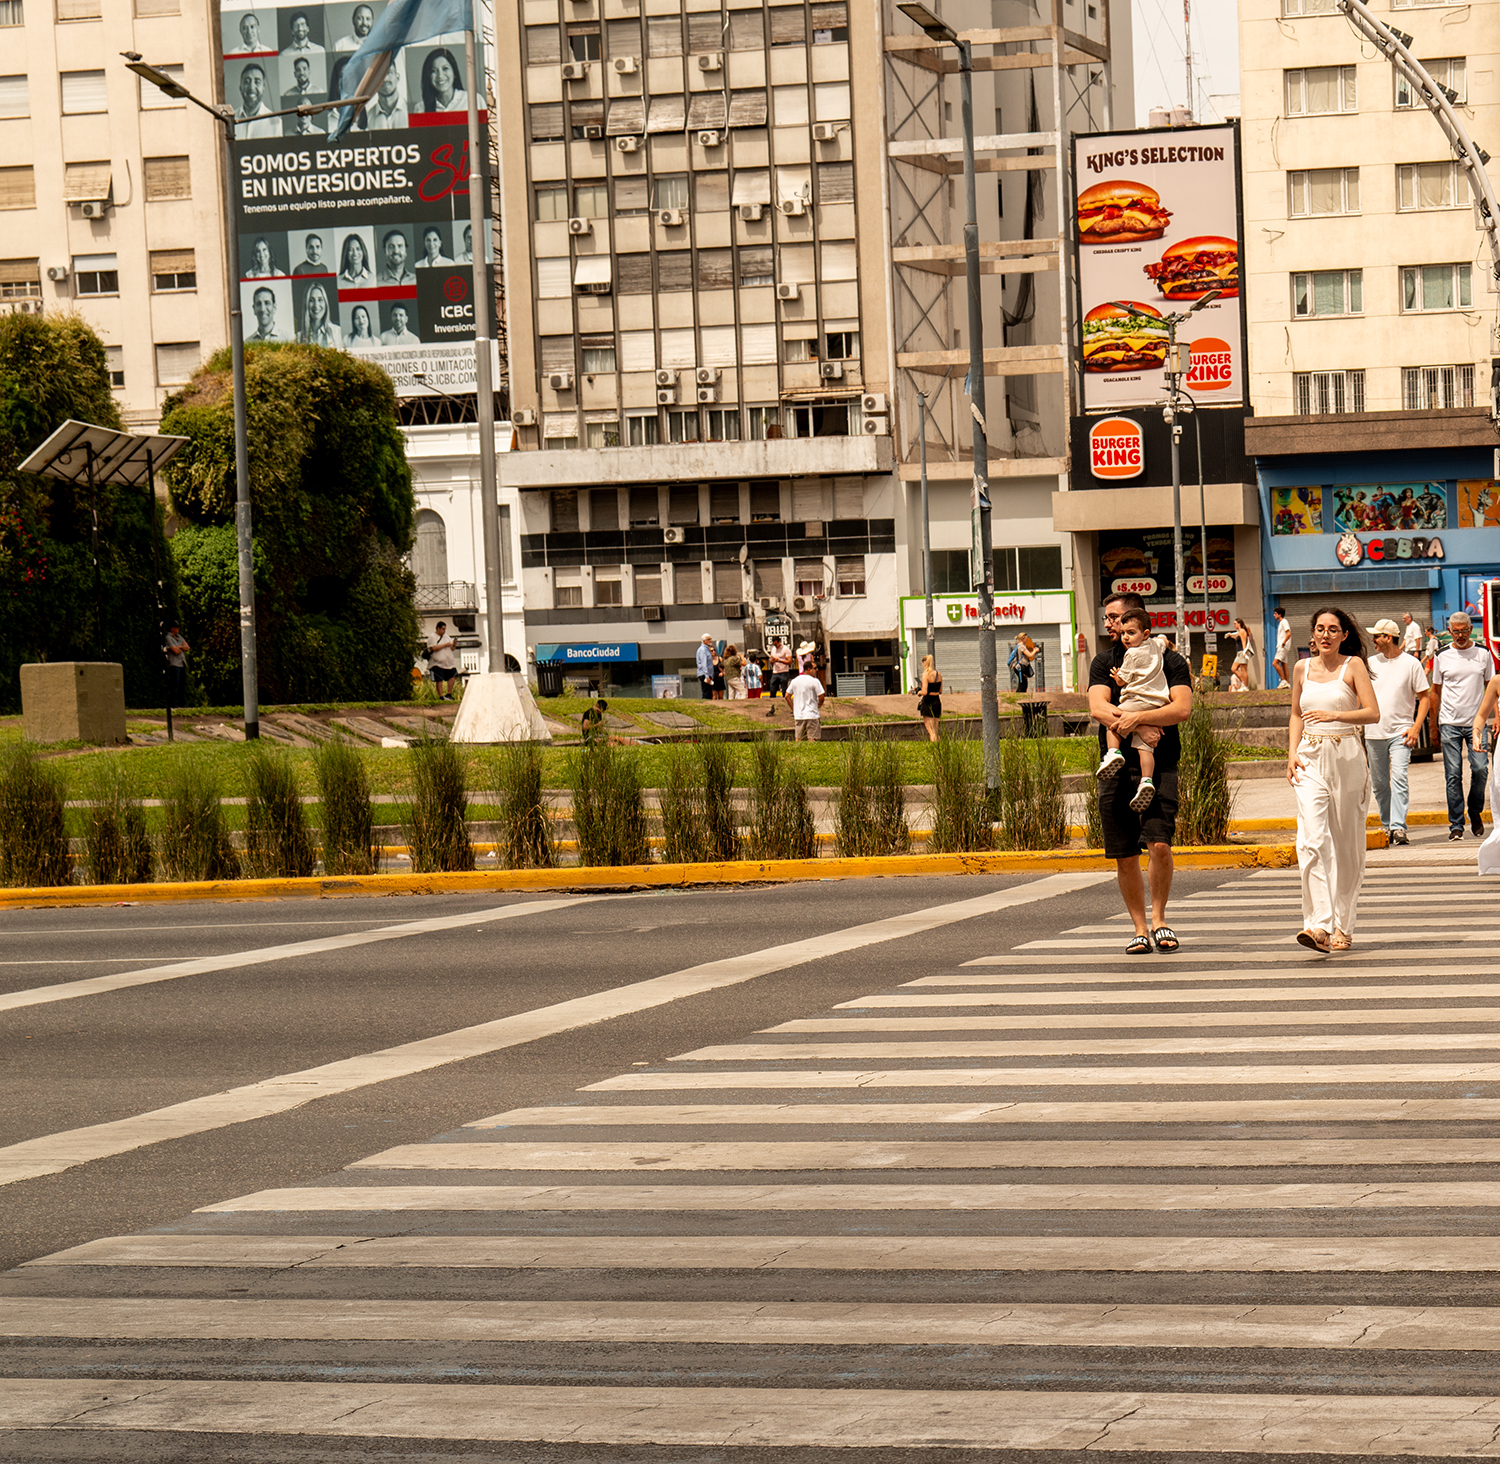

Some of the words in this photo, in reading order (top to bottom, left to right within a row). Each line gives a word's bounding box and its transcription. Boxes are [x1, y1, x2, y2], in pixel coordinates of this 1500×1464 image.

[240, 151, 312, 175] SOMOS
[316, 144, 421, 170] EXPERTOS
[1086, 149, 1139, 173] KING'S
[1141, 146, 1225, 165] SELECTION
[241, 179, 267, 198] EN
[272, 169, 414, 196] INVERSIONES.
[243, 204, 277, 214] Tenemos
[278, 203, 289, 211] un
[290, 201, 317, 212] equipo
[318, 199, 336, 209] listo
[337, 199, 356, 209] para
[356, 195, 413, 207] acompañarte.
[440, 305, 473, 319] ICBC
[434, 323, 477, 333] Inversione
[421, 362, 428, 372] O
[1186, 364, 1232, 381] KING
[1092, 437, 1140, 449] BURGER
[1093, 449, 1141, 466] KING
[1367, 536, 1445, 561] CEBRA
[1117, 582, 1151, 592] $5.490
[965, 602, 1025, 618] faacity
[765, 625, 790, 637] KELLER
[567, 647, 620, 659] BancoCiudad
